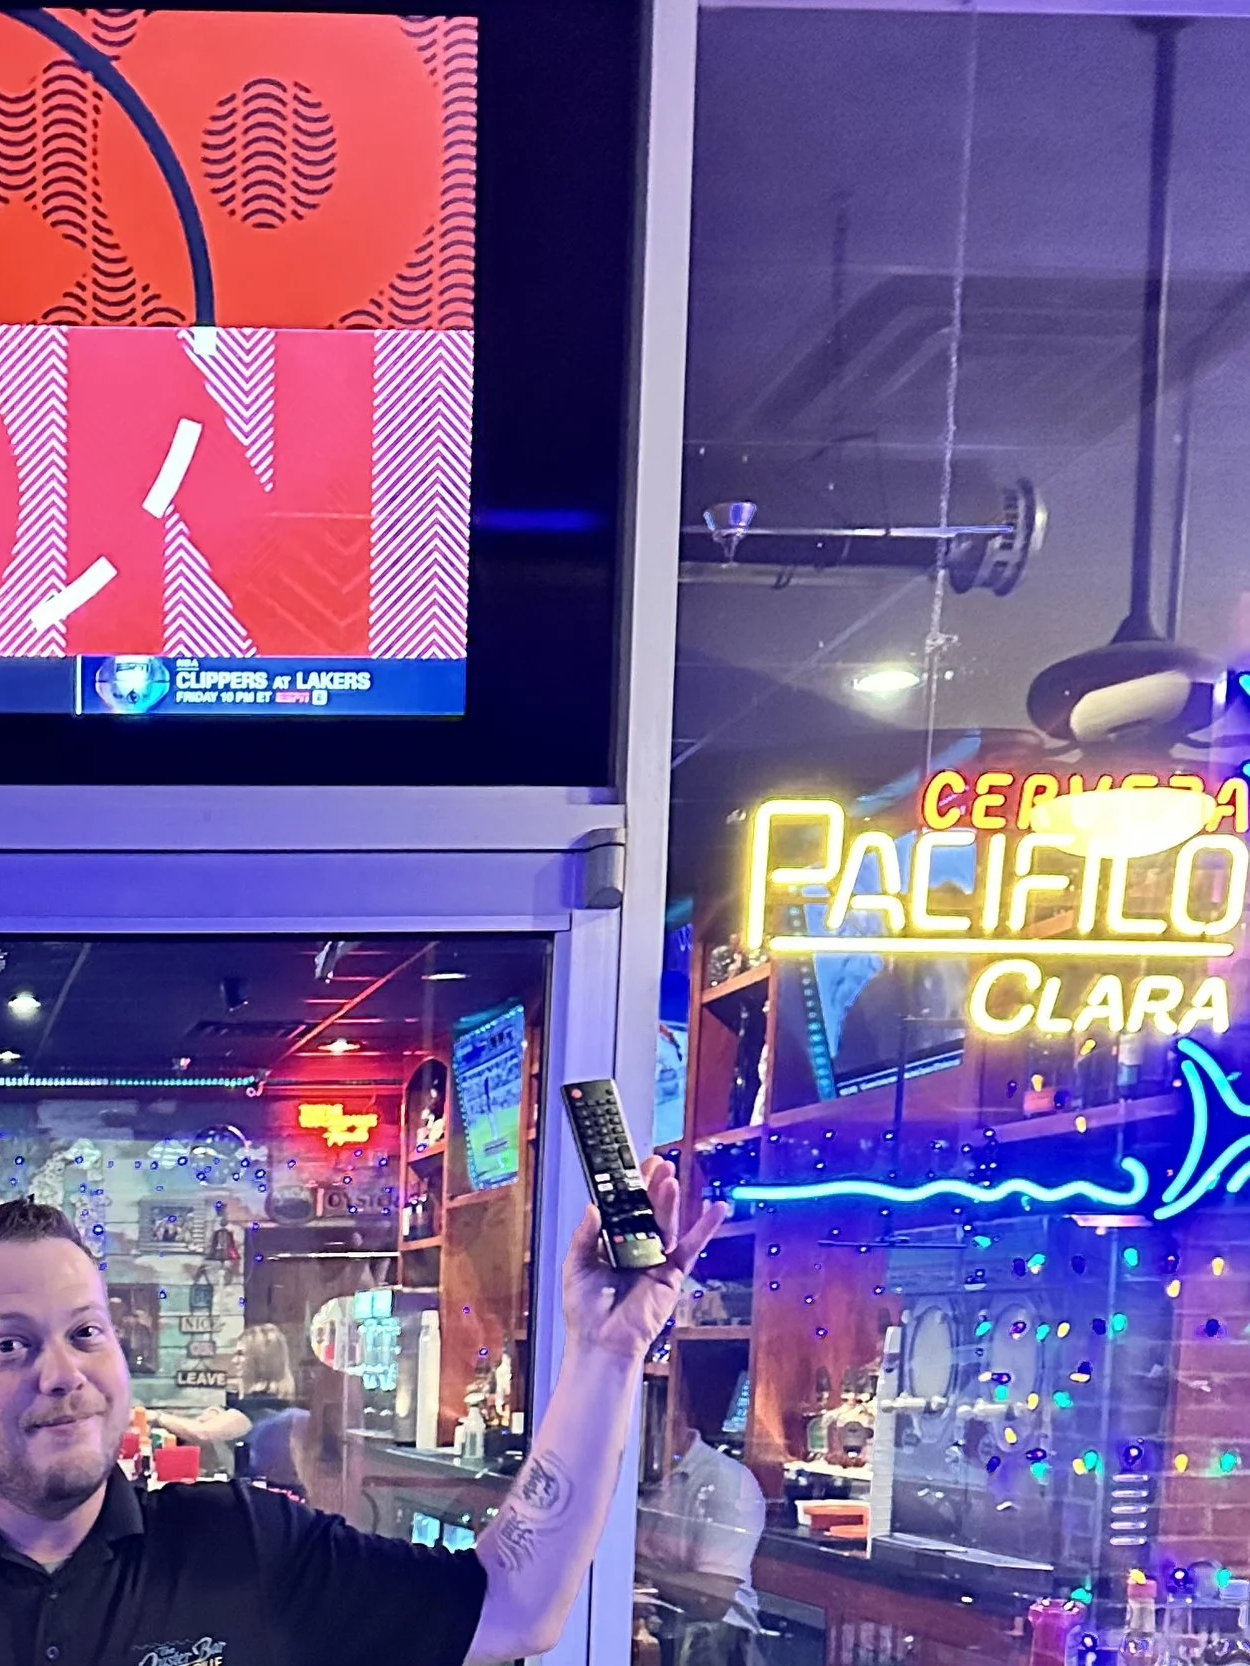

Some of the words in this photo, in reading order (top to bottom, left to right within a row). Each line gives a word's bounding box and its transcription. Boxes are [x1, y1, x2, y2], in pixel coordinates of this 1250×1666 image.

[175, 671, 268, 690] CLIPPERS
[272, 675, 291, 690] AT
[296, 671, 371, 691] LAKERS
[176, 691, 218, 704] FRIDAY
[236, 691, 254, 703] PM
[256, 691, 273, 703] ET
[969, 958, 1230, 1035] CLARA
[177, 1371, 226, 1386] LEAVE
[192, 1636, 227, 1662] Bar
